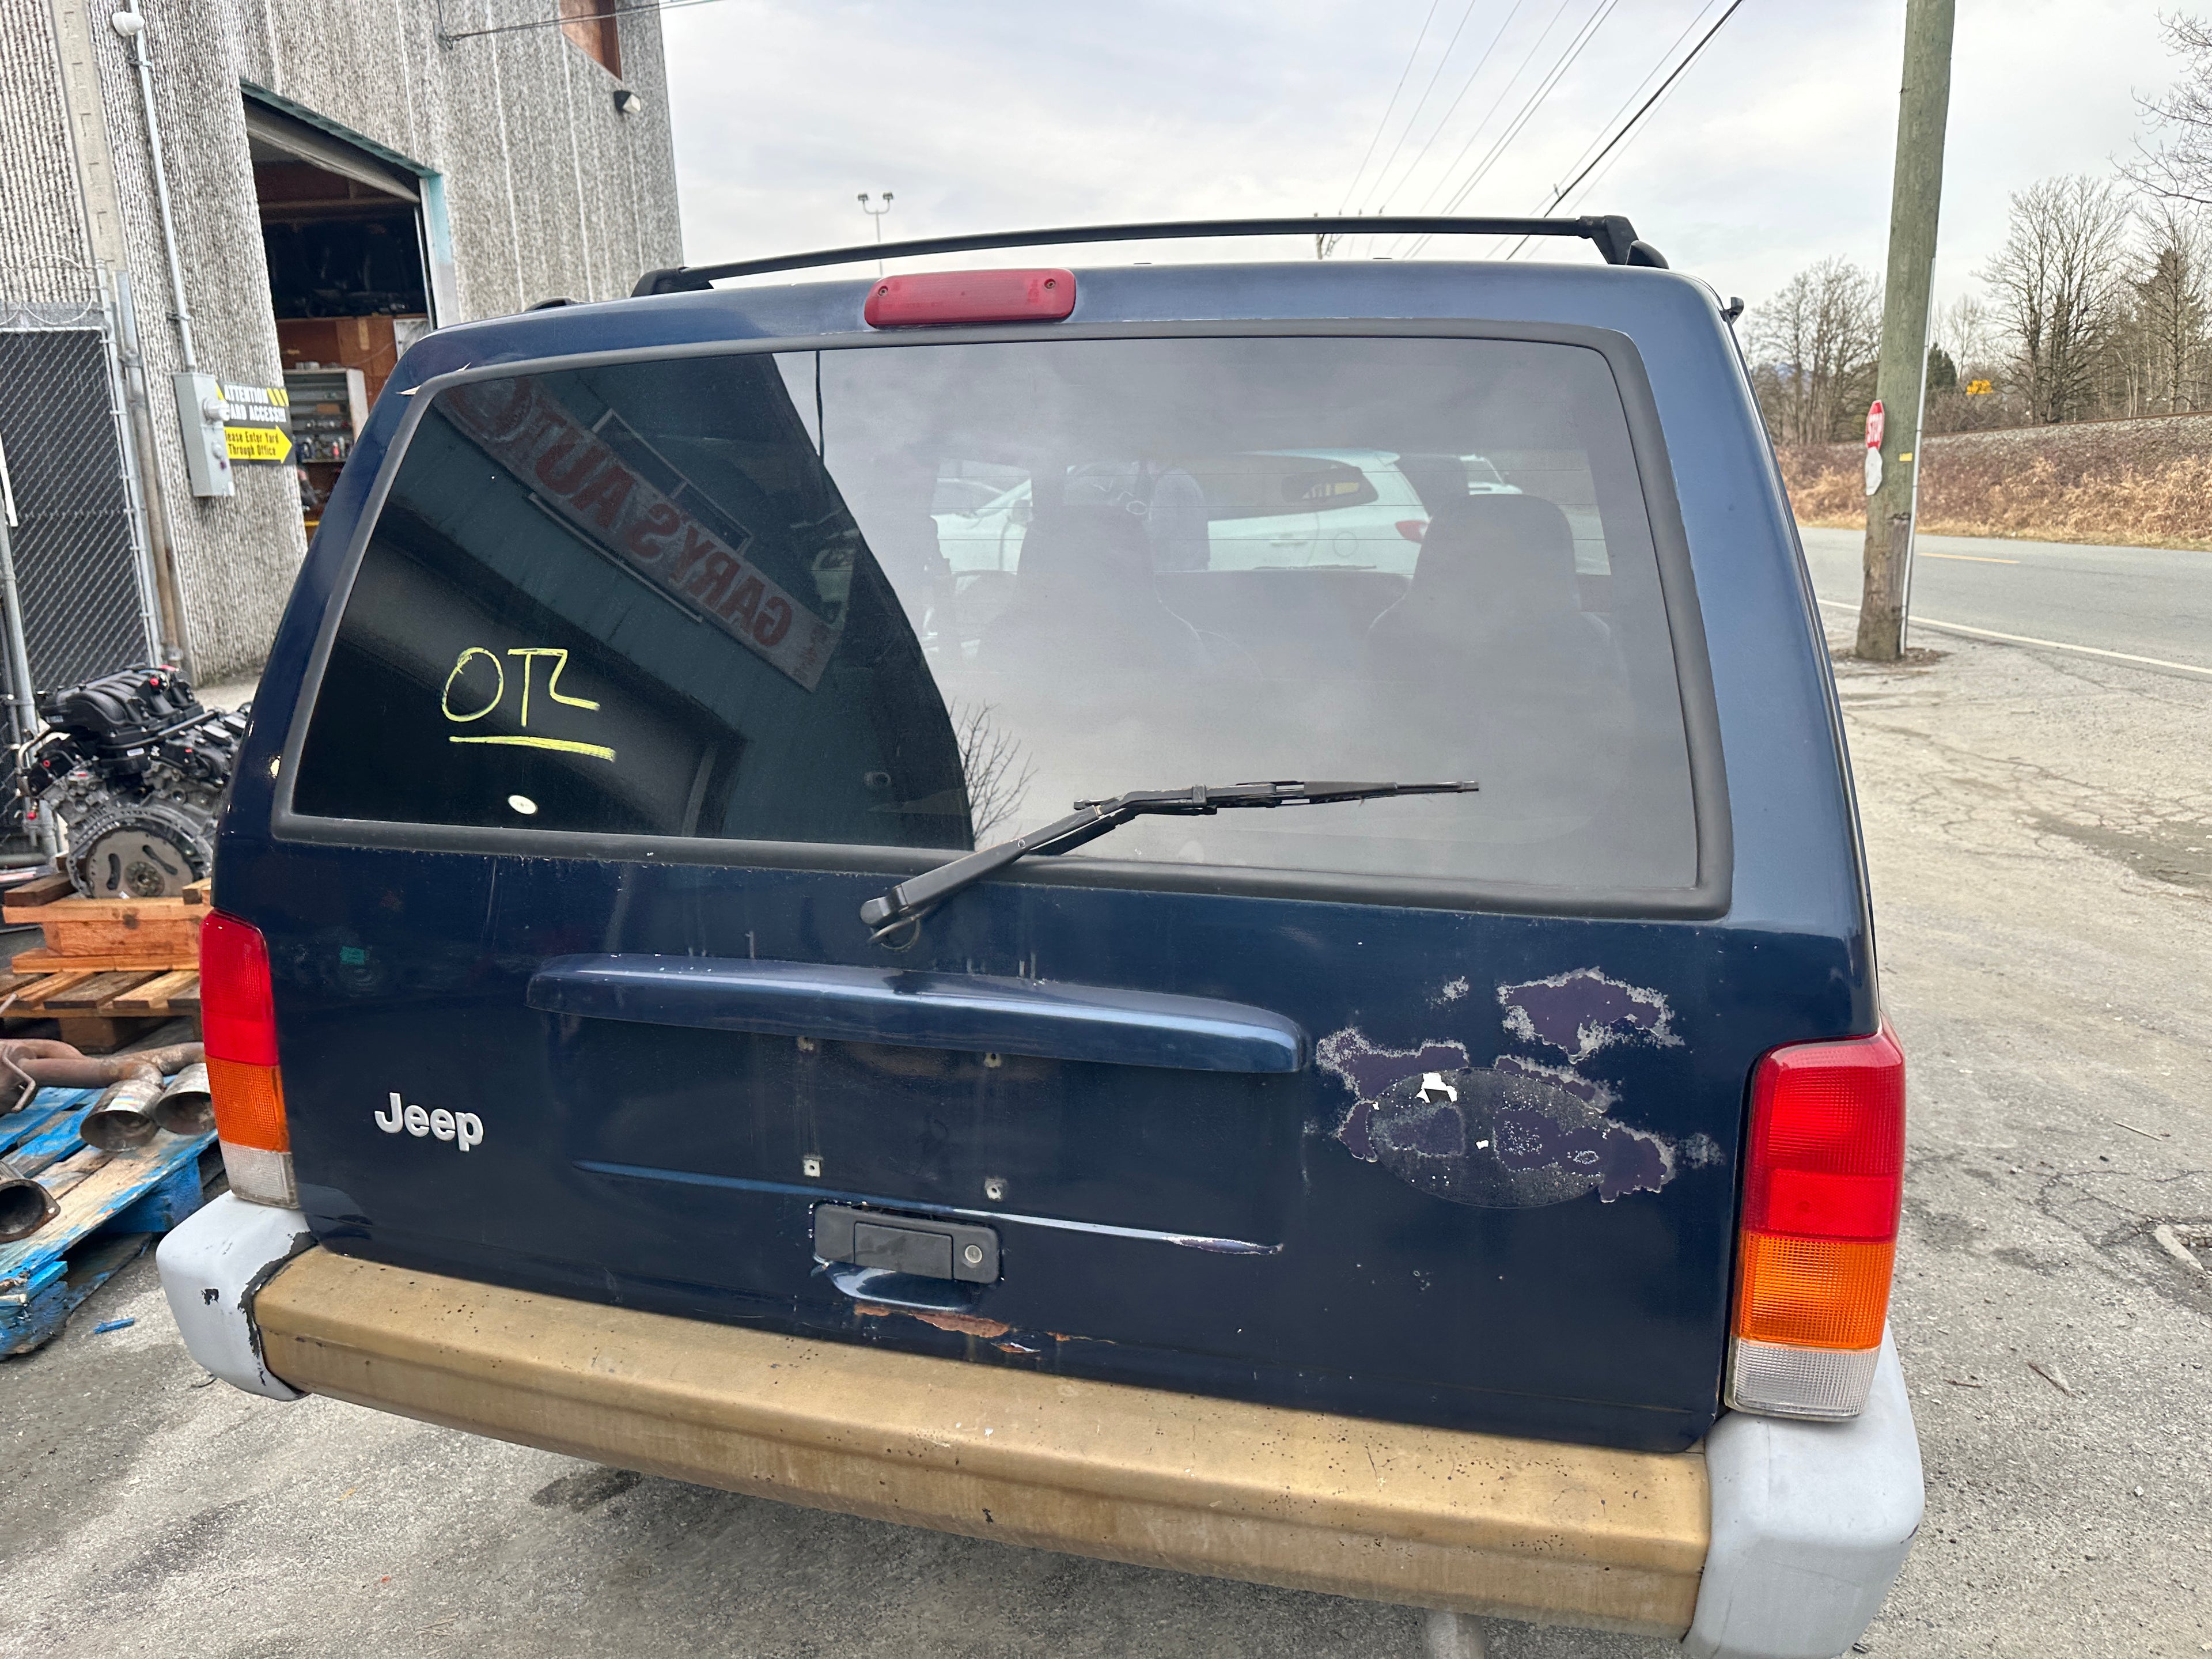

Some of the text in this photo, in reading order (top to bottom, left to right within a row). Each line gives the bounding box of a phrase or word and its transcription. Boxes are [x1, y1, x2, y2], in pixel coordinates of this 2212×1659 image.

[224, 384, 269, 404] ATTENTION
[230, 403, 247, 421] ARD
[225, 430, 279, 444] lease Enter Yard
[228, 443, 276, 459] Through Office
[374, 1092, 484, 1152] Jeep
